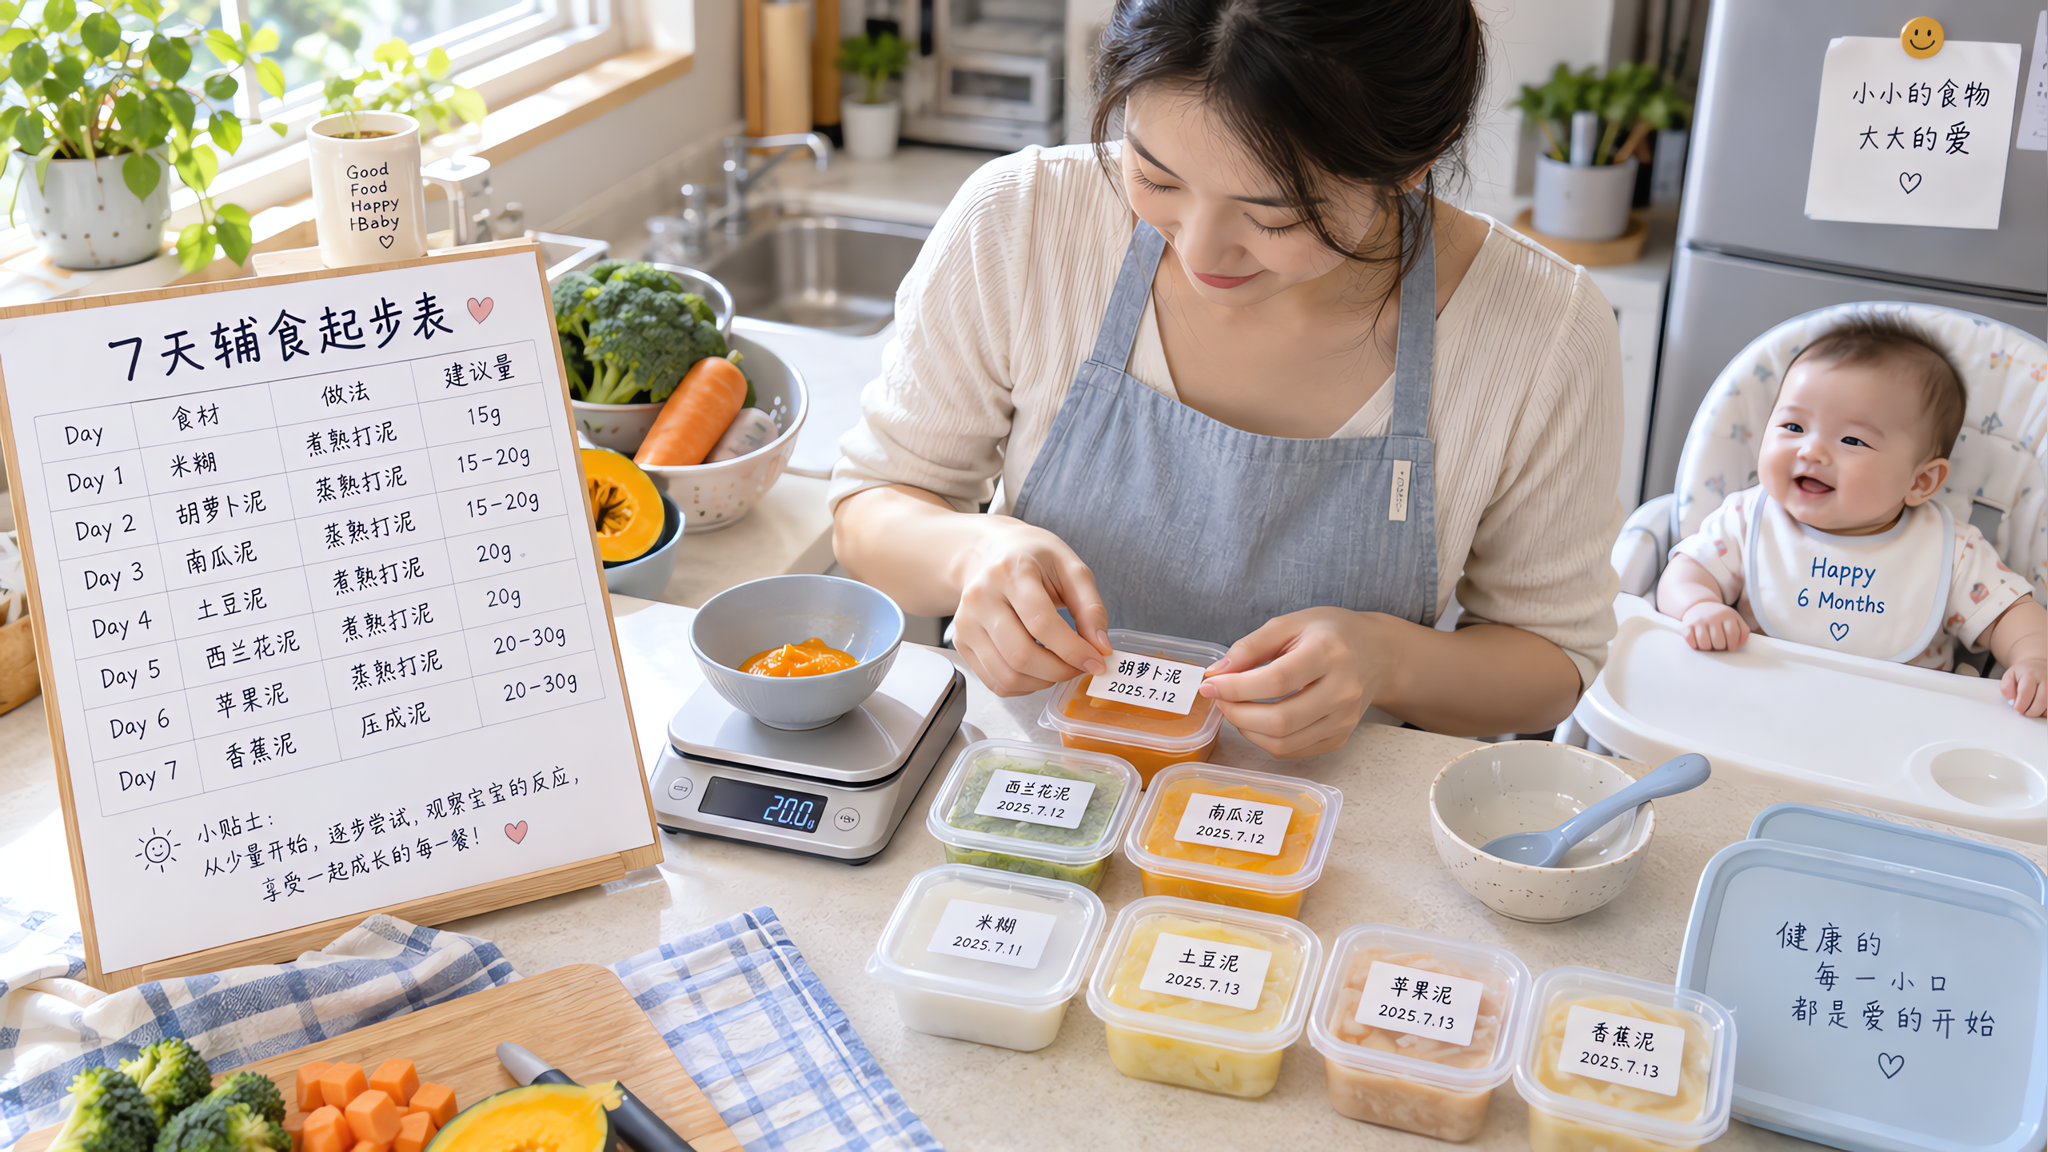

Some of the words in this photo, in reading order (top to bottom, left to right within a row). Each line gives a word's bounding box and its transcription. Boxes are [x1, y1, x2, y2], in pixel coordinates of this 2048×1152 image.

[1852, 78, 1990, 108] 小小的食物
[1859, 120, 1971, 155] 大大的爱
[346, 161, 390, 180] Good
[350, 180, 388, 197] Food
[351, 198, 400, 214] Happy
[108, 291, 454, 382] 7天辅食起步表
[443, 353, 515, 389] 建议量
[321, 380, 370, 407] 做法
[172, 402, 219, 432] 食材
[467, 405, 501, 427] 15g
[64, 425, 103, 447] Day
[306, 420, 398, 458] 煮熟打泥
[170, 451, 217, 478] 米糊
[457, 446, 530, 473] 15-20g
[67, 473, 104, 495] Day
[114, 466, 123, 485] 1
[315, 465, 407, 504] 蒸熟打泥
[175, 490, 267, 525] 胡萝卜泥
[467, 491, 539, 518] 15-20g
[75, 521, 112, 544] Day
[122, 513, 137, 533] 2
[324, 510, 416, 550] 蒸熟打泥
[185, 540, 258, 575] 南瓜泥
[476, 543, 512, 564] 20g
[83, 570, 121, 592] Day
[131, 561, 144, 582] 3
[332, 556, 425, 596] 煮熟打泥
[1811, 556, 1877, 589] Happy
[197, 587, 268, 621] 土豆泥
[486, 588, 521, 609] 20g
[1797, 587, 1809, 608] 6
[1818, 591, 1885, 614] Months
[92, 618, 129, 641] Day
[138, 610, 153, 630] 4
[341, 602, 434, 643] 煮熟打泥
[205, 629, 301, 670] 西兰花泥
[493, 626, 566, 655] 20-30g
[100, 668, 138, 690] Day
[148, 658, 161, 679] 5
[350, 649, 443, 691] 蒸熟打泥
[1118, 660, 1182, 684] 胡萝卜泥
[215, 682, 289, 719] 苹果泥
[503, 672, 577, 702] 20-30g
[1108, 681, 1176, 703] 2025.7.12
[109, 718, 147, 741] Day
[157, 708, 170, 729] 6
[361, 701, 431, 739] 压成泥
[225, 732, 297, 770] 香蕉泥
[118, 770, 156, 792] Day
[164, 760, 177, 780] 7
[1005, 780, 1071, 801] 西兰花泥
[996, 800, 1065, 819] 2025.7.12
[1208, 803, 1264, 826] 南瓜泥
[1195, 825, 1265, 845] 2025.7.12
[975, 914, 1017, 935] 米糊
[952, 935, 1022, 957] 2025.7.11
[1178, 948, 1239, 973] 土豆泥
[1165, 973, 1241, 996] 2025.7.13
[1390, 976, 1453, 1005] 苹果泥
[1378, 1006, 1455, 1031] 2025.7.13
[1591, 1021, 1655, 1052] 香蕉泥
[1580, 1051, 1660, 1079] 2025.7.13
